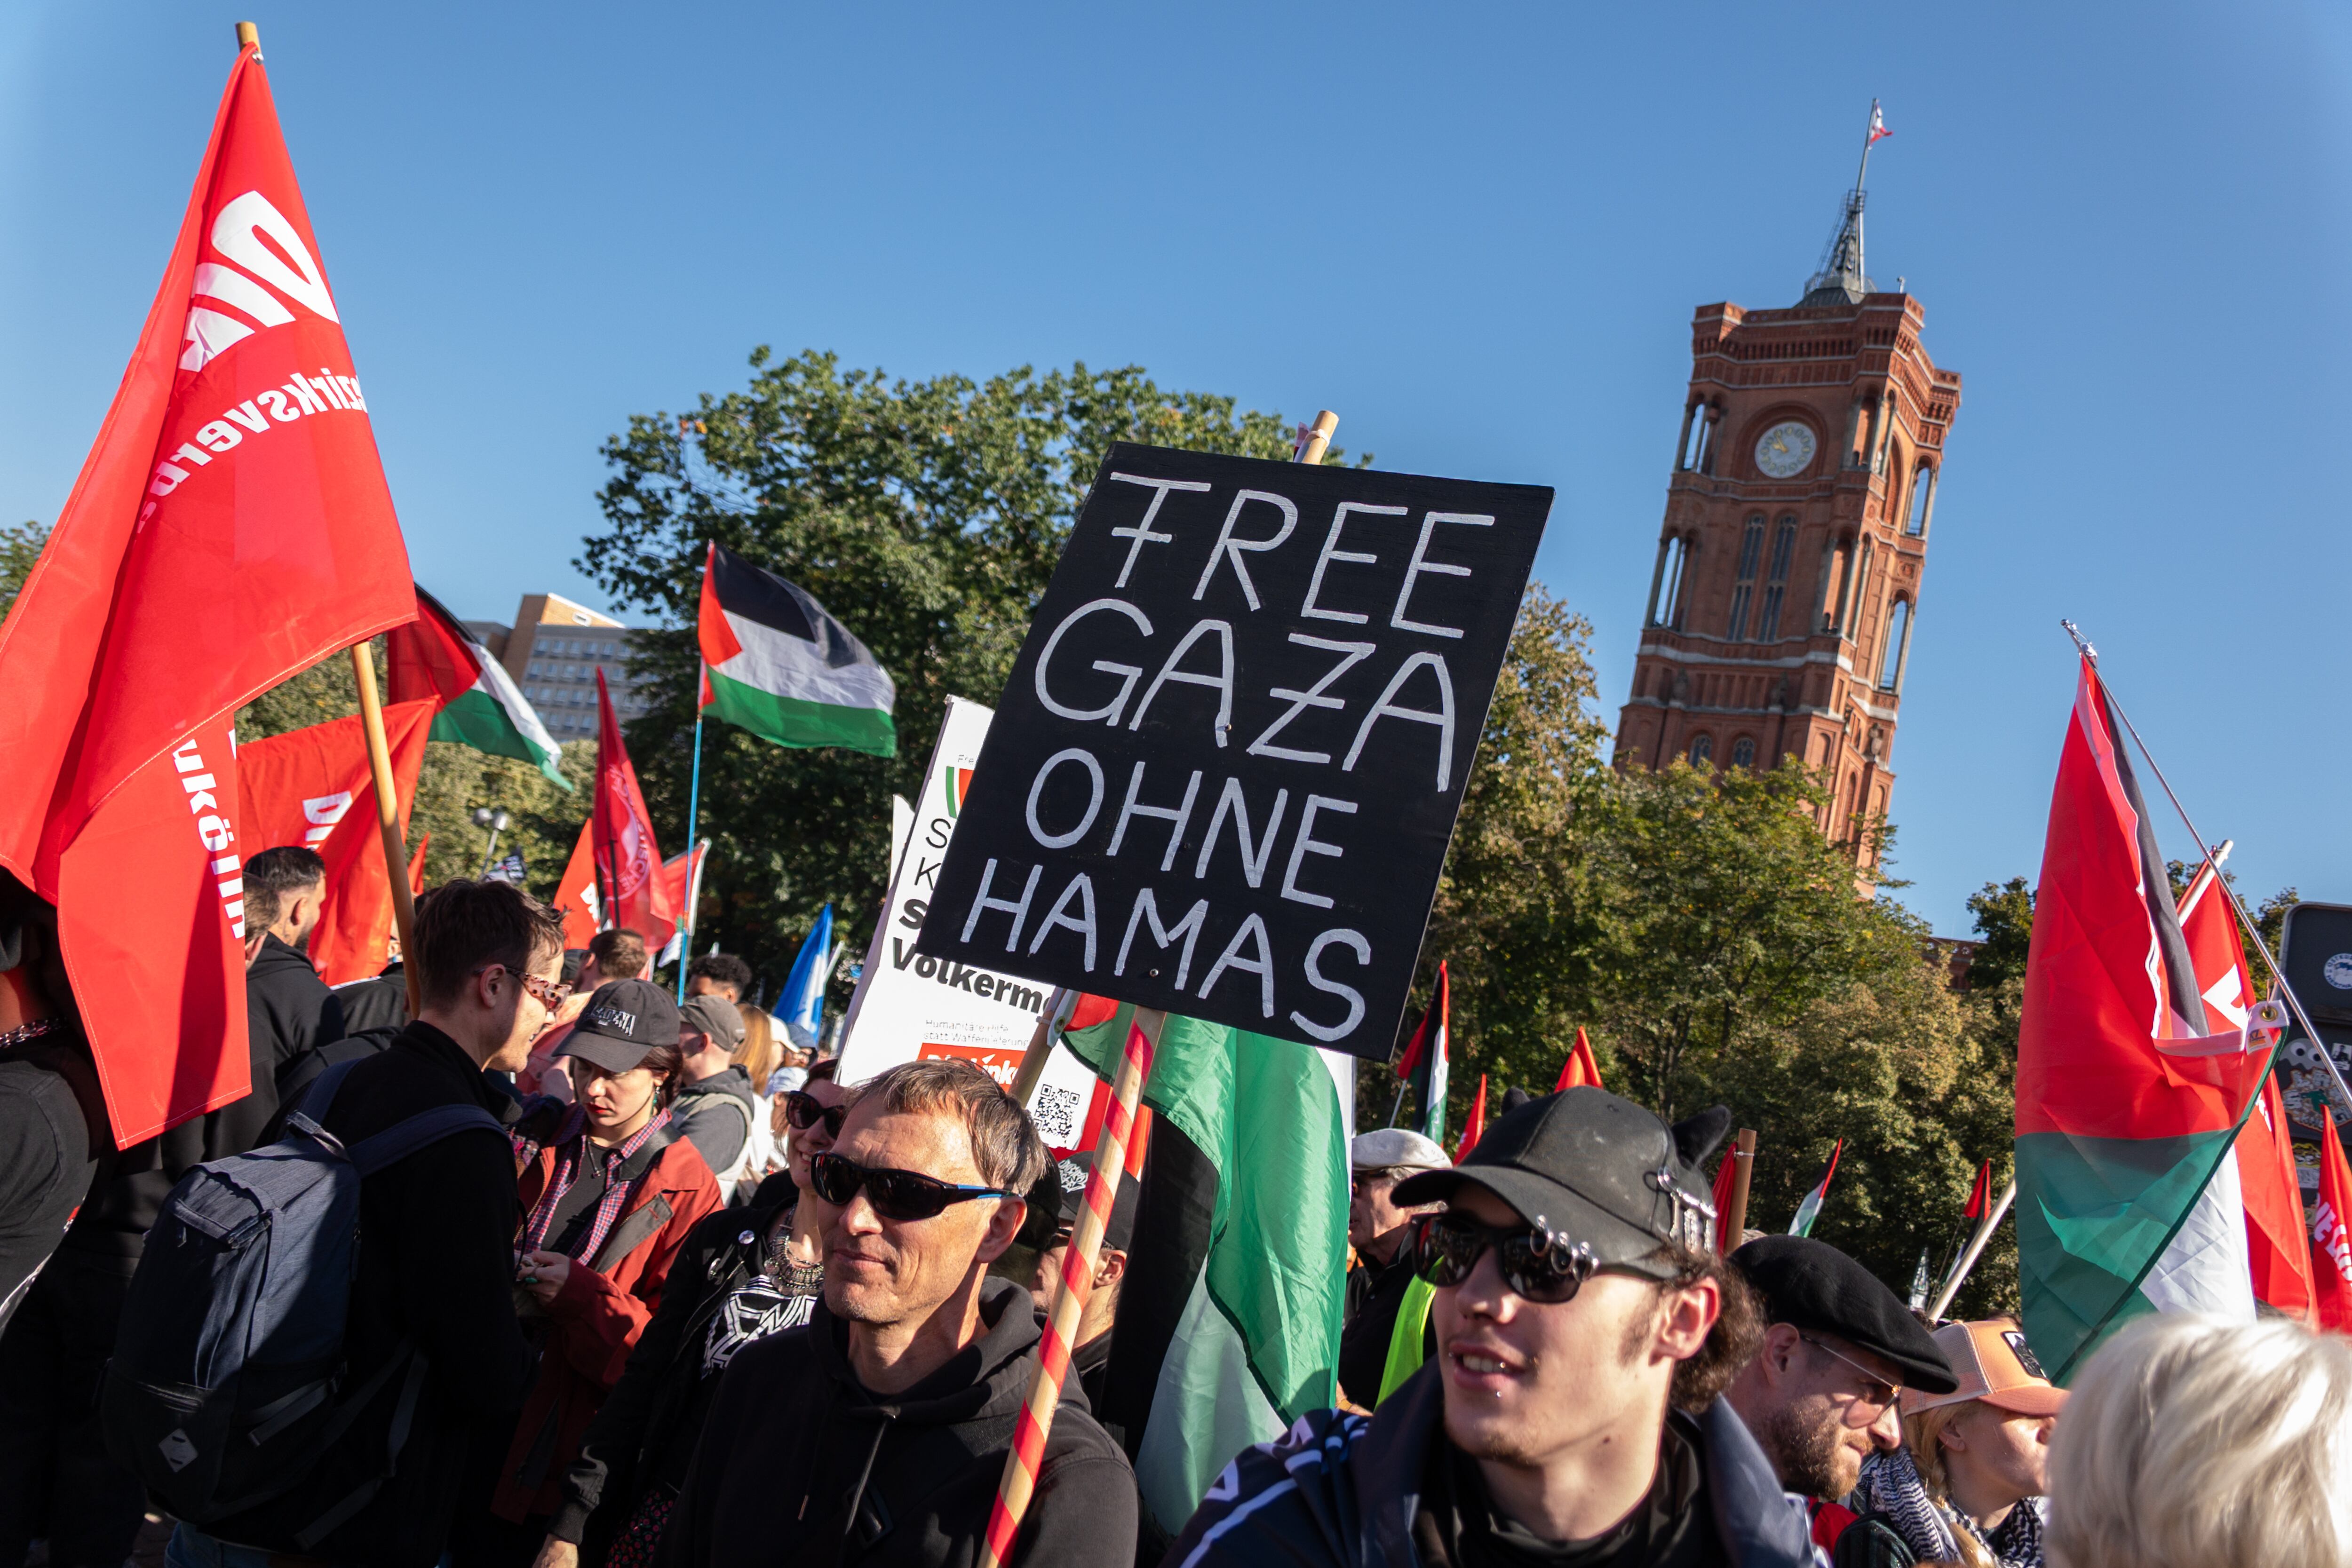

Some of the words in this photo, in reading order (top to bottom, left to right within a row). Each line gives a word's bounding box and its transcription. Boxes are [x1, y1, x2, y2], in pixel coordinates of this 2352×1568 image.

[1111, 471, 1495, 639] FREE
[1035, 598, 1455, 792] GAZA
[1025, 747, 1358, 909] OHNE
[893, 936, 1052, 1014] Vlkerm
[960, 858, 1372, 1042] HAMAS
[971, 1053, 1018, 1085] ink
